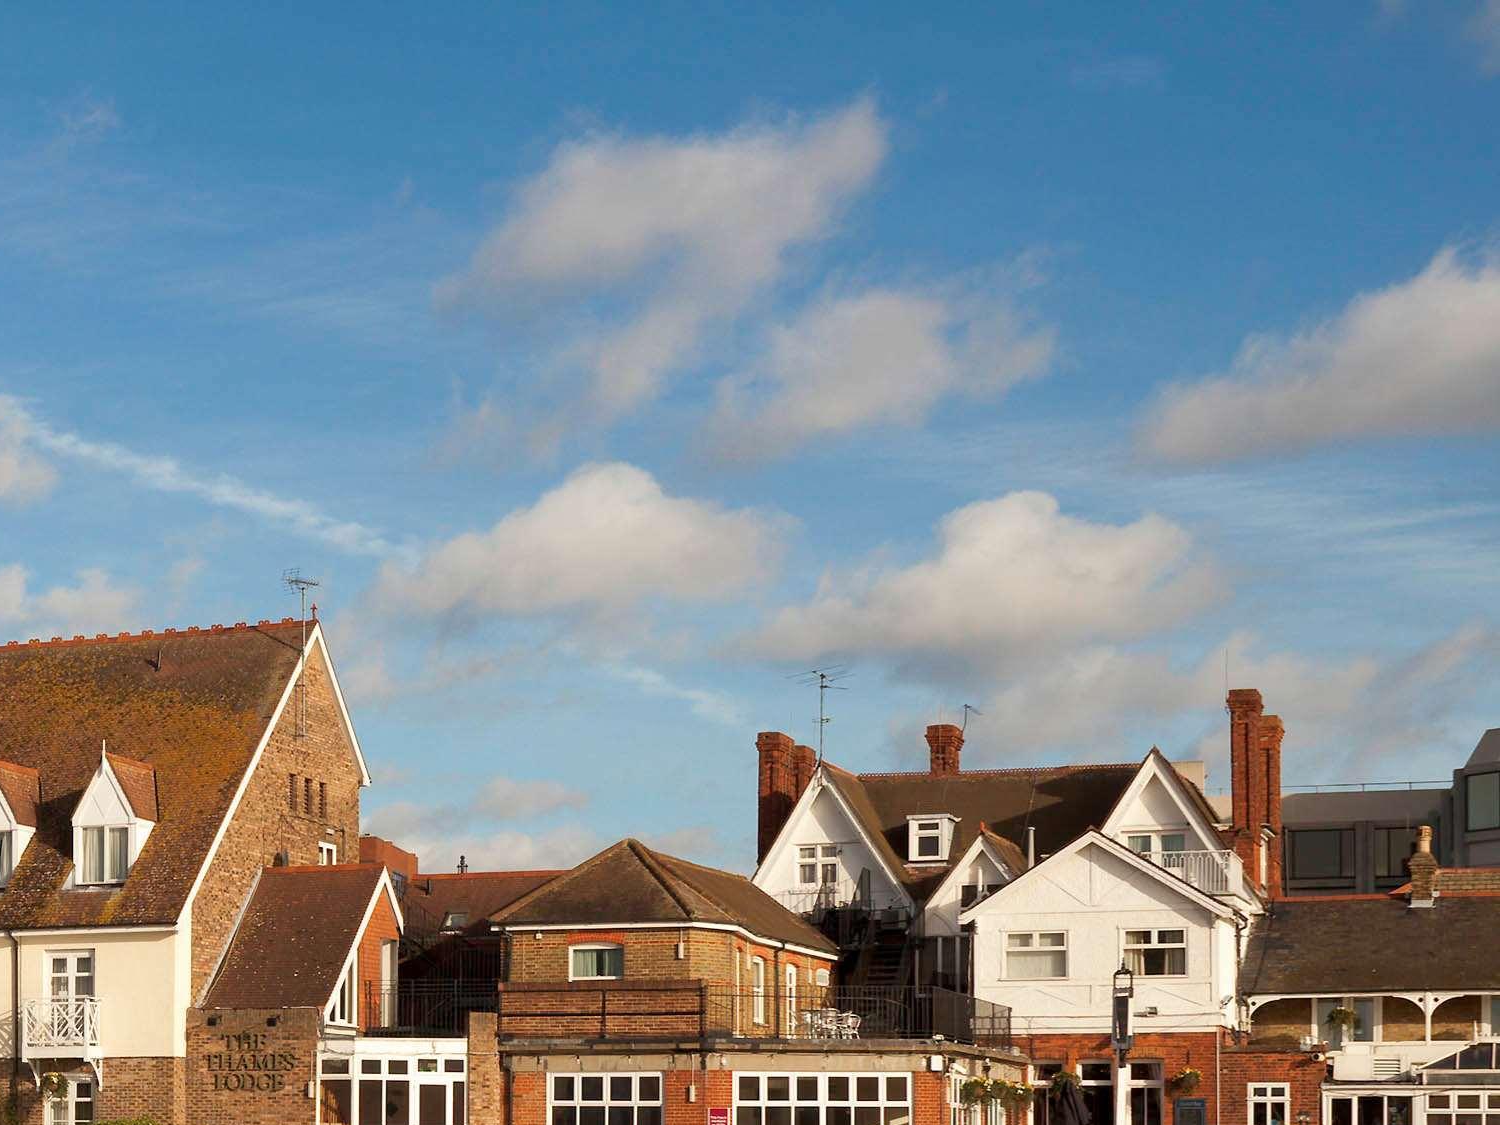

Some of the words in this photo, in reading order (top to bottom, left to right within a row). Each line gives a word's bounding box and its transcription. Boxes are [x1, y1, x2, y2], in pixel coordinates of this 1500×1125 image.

[220, 1033, 268, 1051] THE
[205, 1053, 296, 1072] THAMES
[213, 1073, 285, 1092] LODGE
